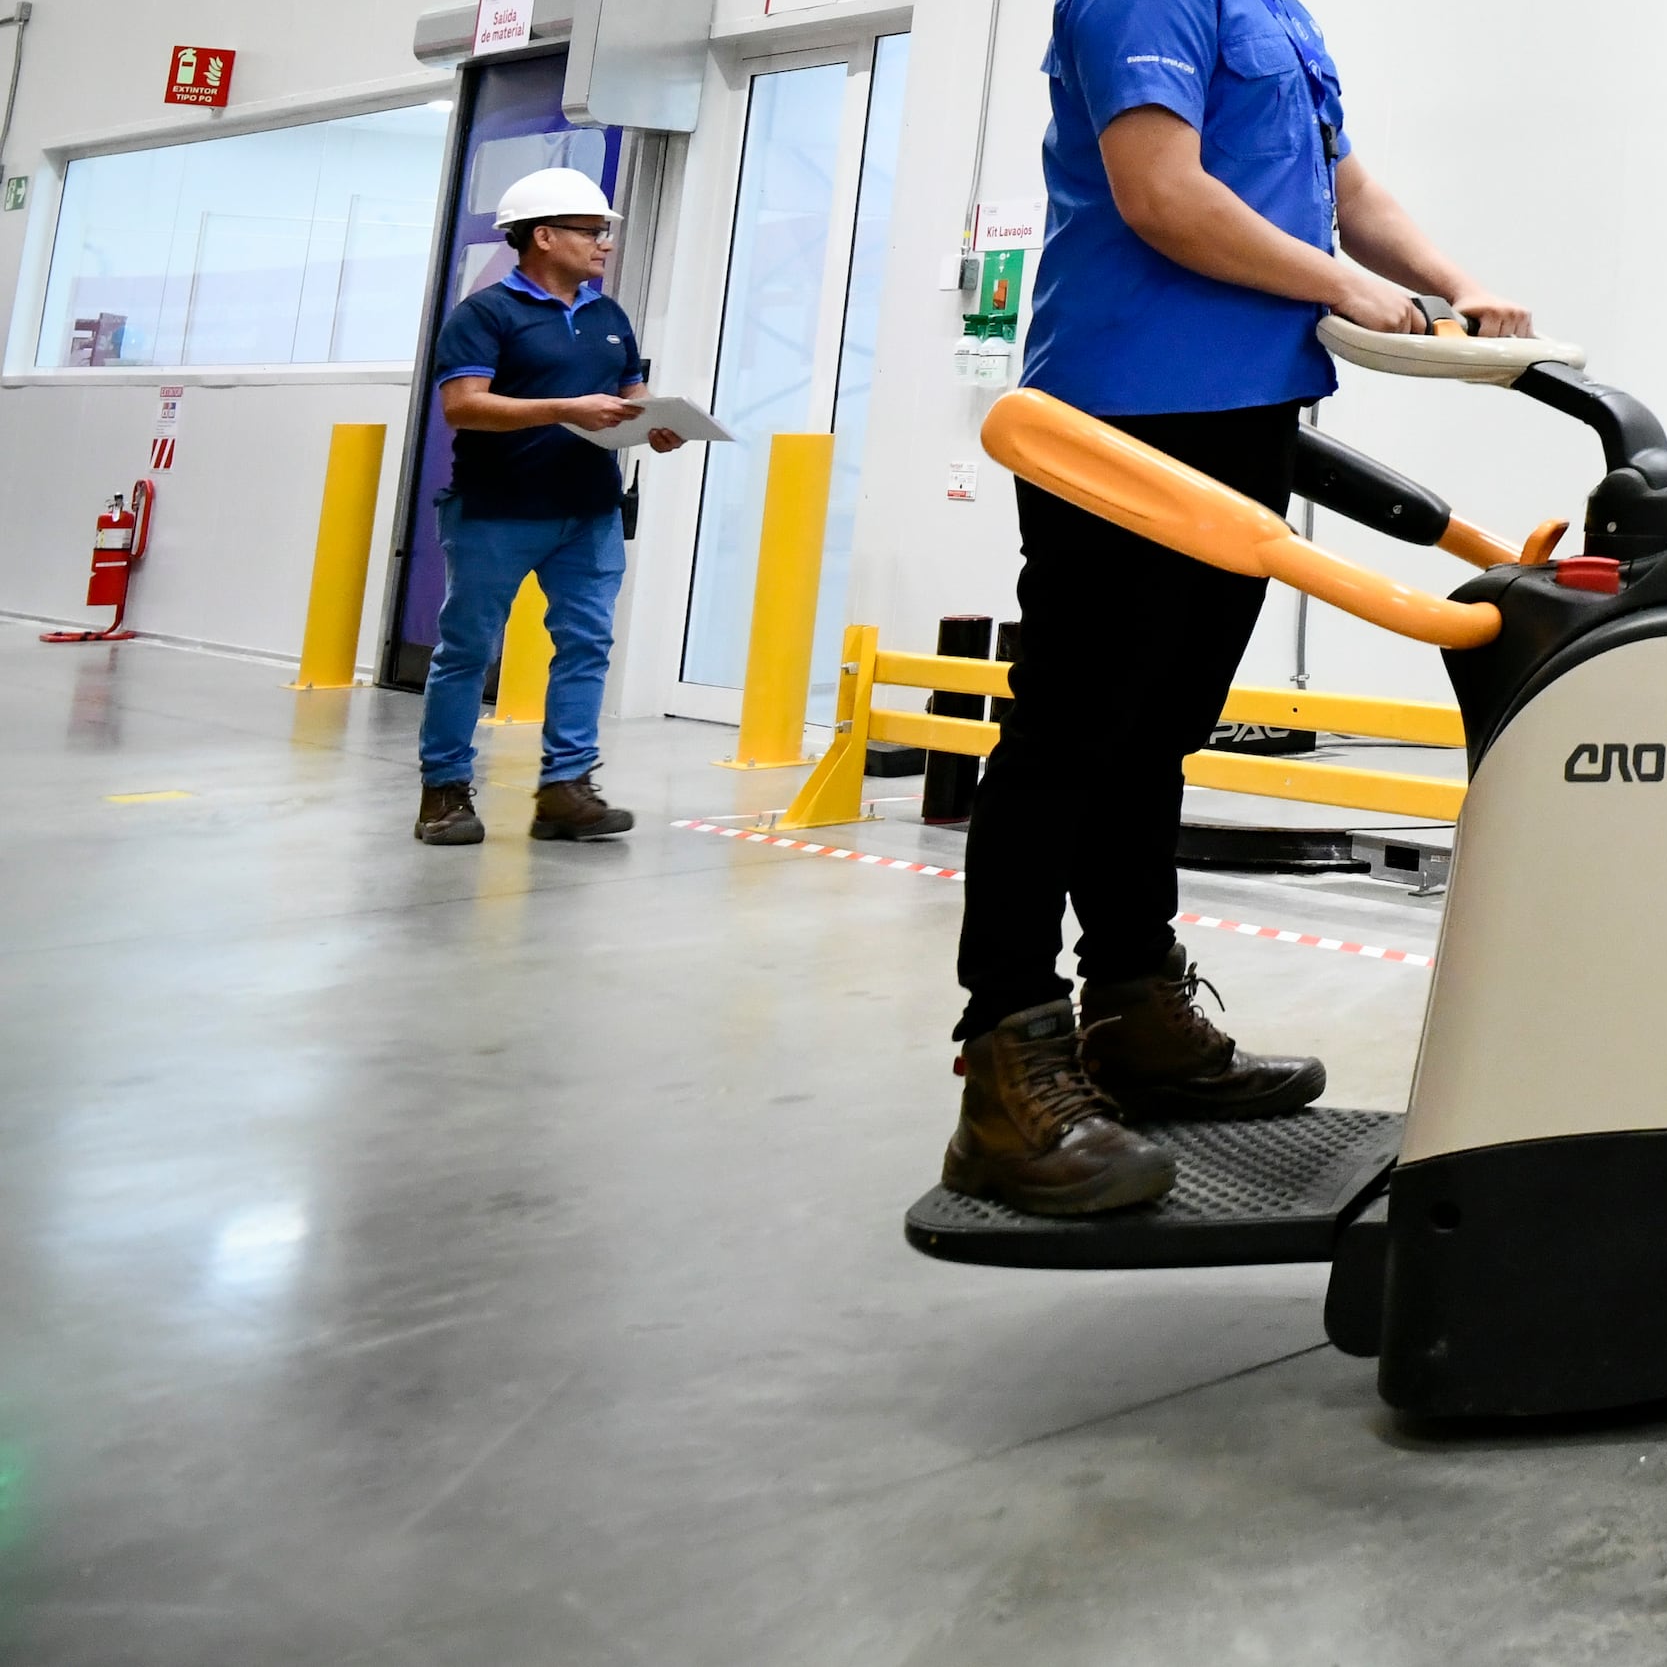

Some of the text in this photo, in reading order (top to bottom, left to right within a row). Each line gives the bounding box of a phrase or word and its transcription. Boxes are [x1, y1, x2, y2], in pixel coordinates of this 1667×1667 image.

[493, 8, 517, 26] Salida
[481, 21, 525, 44] de material
[172, 85, 218, 95] EXTINTOR
[176, 94, 213, 103] TIPO PQ
[986, 224, 1033, 239] Kit Lavaojos
